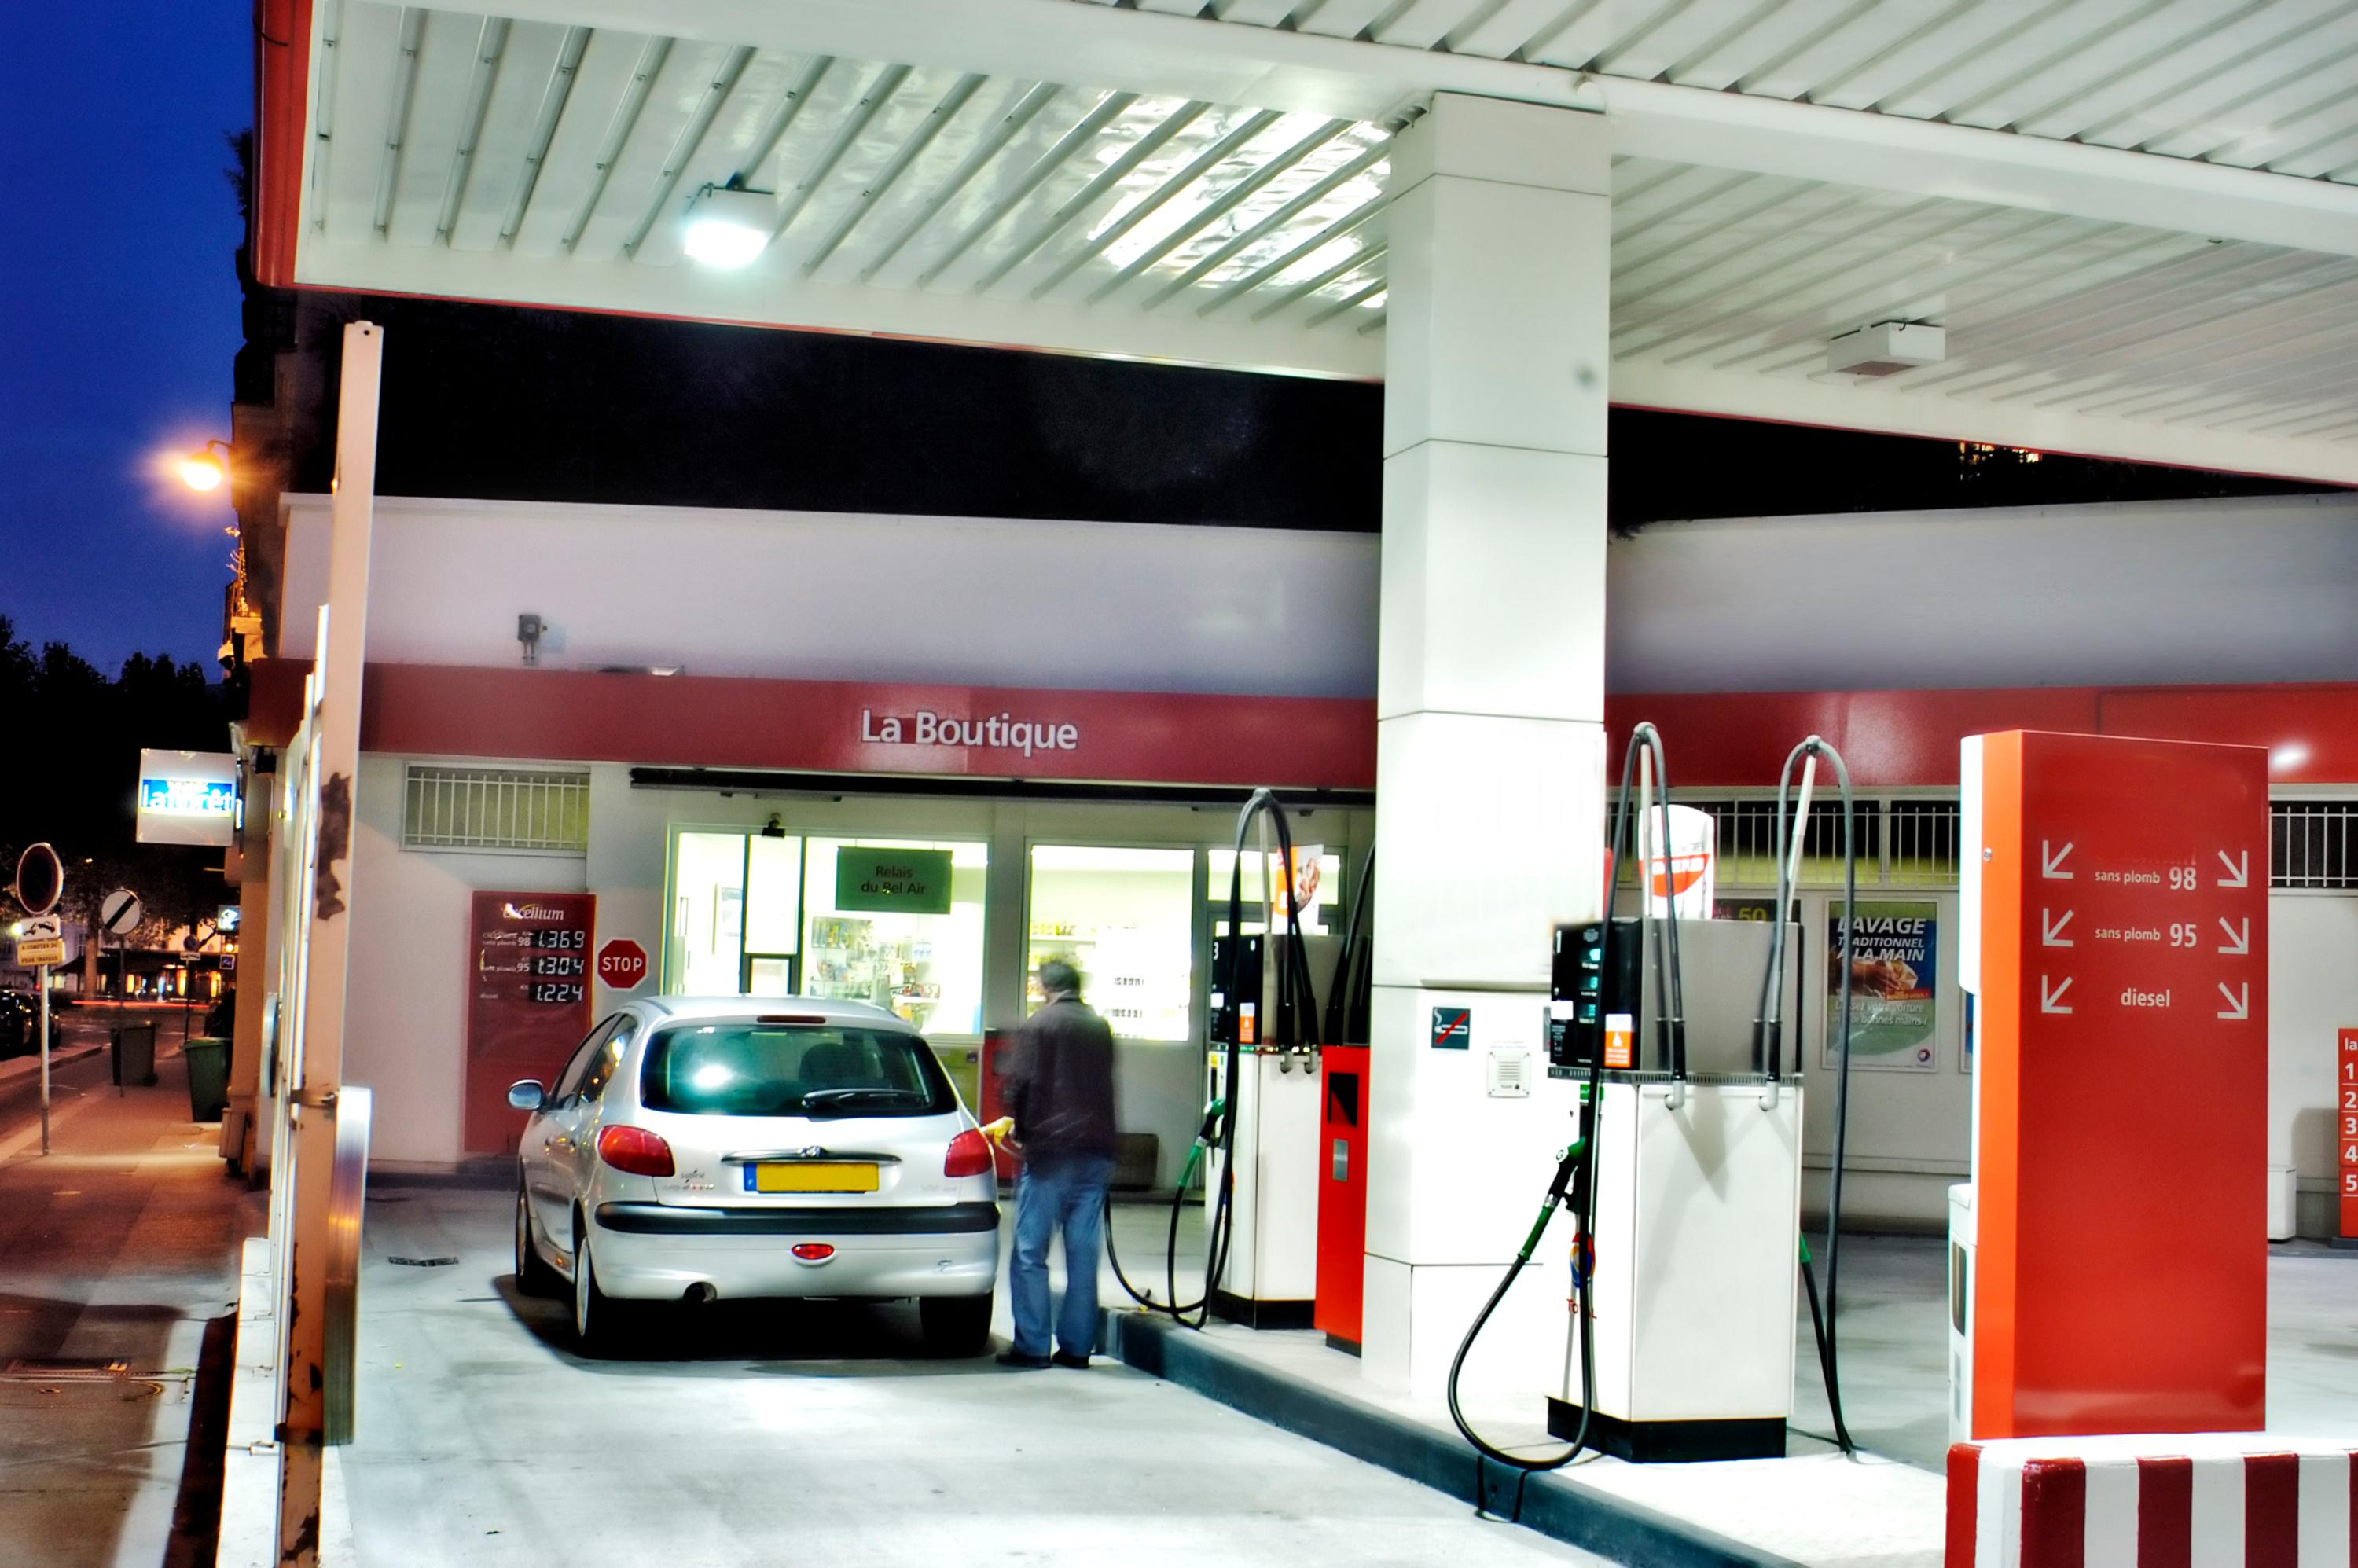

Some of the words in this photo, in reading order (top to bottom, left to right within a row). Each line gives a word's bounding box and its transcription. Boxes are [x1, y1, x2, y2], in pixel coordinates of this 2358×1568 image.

[861, 709, 902, 744] La
[915, 710, 1079, 758] Boutique
[876, 865, 914, 879] Relais
[2095, 871, 2121, 882] sans
[2124, 870, 2161, 885] plomb
[2169, 866, 2198, 890] 98
[861, 880, 878, 893] du
[882, 881, 903, 894] Bel
[907, 883, 927, 894] Air
[1837, 916, 1926, 935] LAVAGE
[518, 937, 531, 946] 98
[538, 931, 585, 948] 1.369
[1838, 937, 1925, 949] TADITIONNEL
[2095, 928, 2121, 938] sans
[2124, 927, 2161, 942] plomb
[2169, 923, 2198, 948] 95
[1853, 948, 1874, 960] LA
[1879, 949, 1925, 962] MAIN
[516, 963, 531, 972] 95
[601, 957, 643, 972] STOP
[537, 984, 583, 1002] 1.224
[2121, 987, 2170, 1008] diesel
[1835, 1003, 1864, 1012] Lsez
[2345, 1063, 2355, 1080] 1
[2344, 1091, 2357, 1109] 2
[2345, 1117, 2357, 1135] 3
[2345, 1144, 2358, 1162] 4
[2345, 1173, 2357, 1192] 5
[1566, 1298, 1597, 1319] TOL
